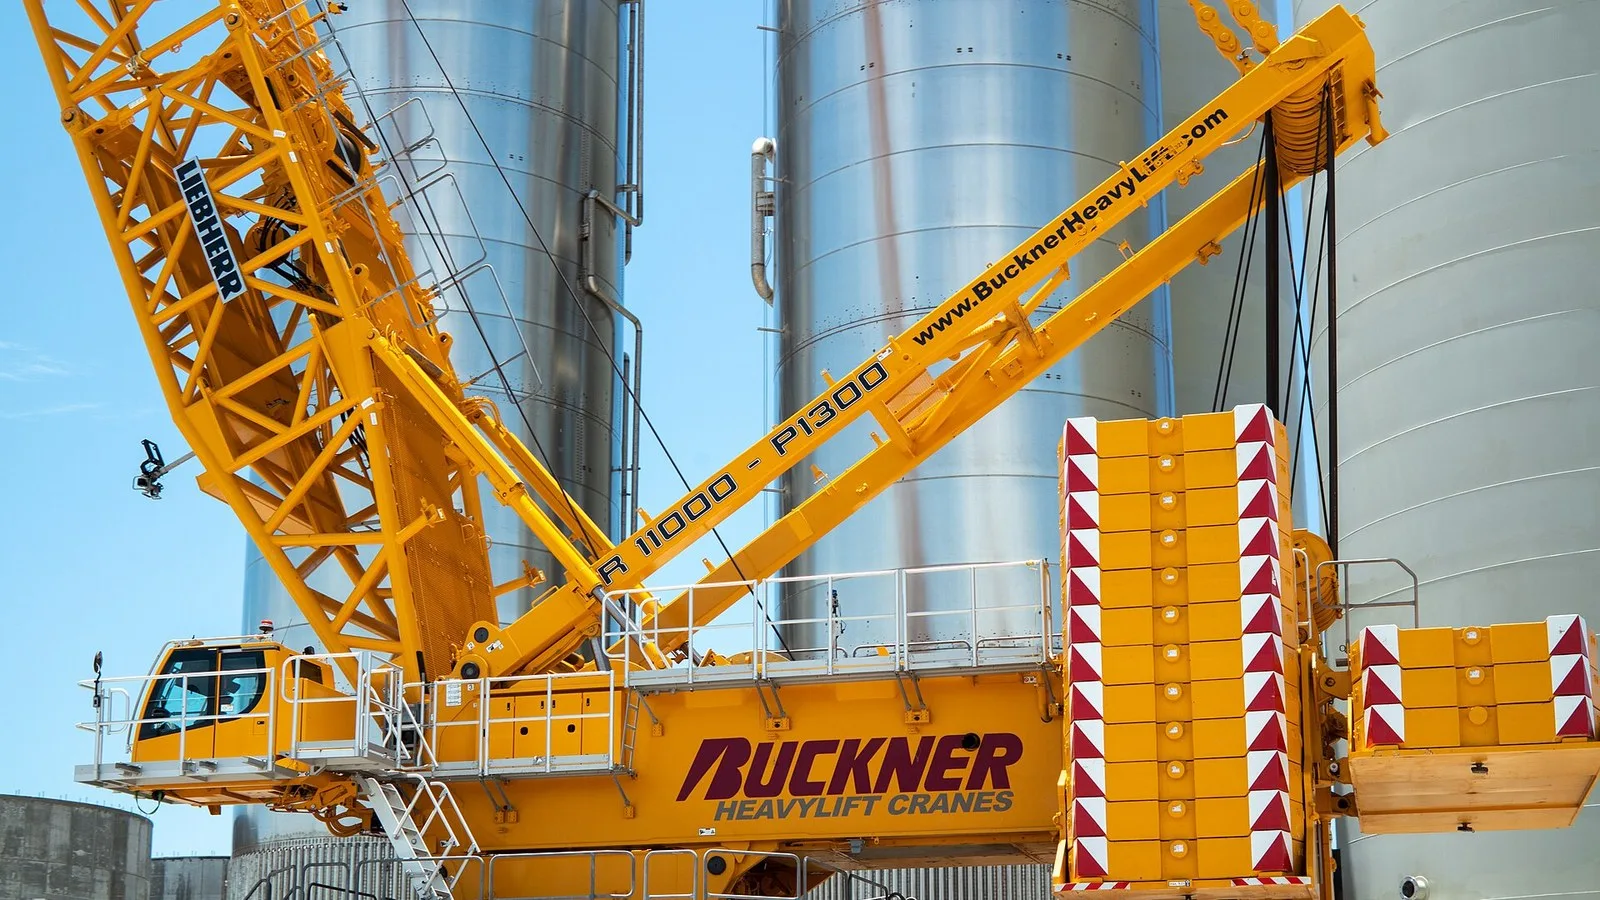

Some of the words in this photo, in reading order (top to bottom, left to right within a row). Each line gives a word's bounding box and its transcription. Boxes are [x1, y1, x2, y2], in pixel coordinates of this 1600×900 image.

[176, 160, 242, 300] LIEBHERR
[634, 472, 738, 557] 11000
[747, 458, 762, 470] -
[769, 361, 889, 457] P1300
[676, 732, 1023, 802] BUCKNER
[714, 795, 882, 821] HEAVYLIFT
[887, 790, 1015, 816] CRANES
